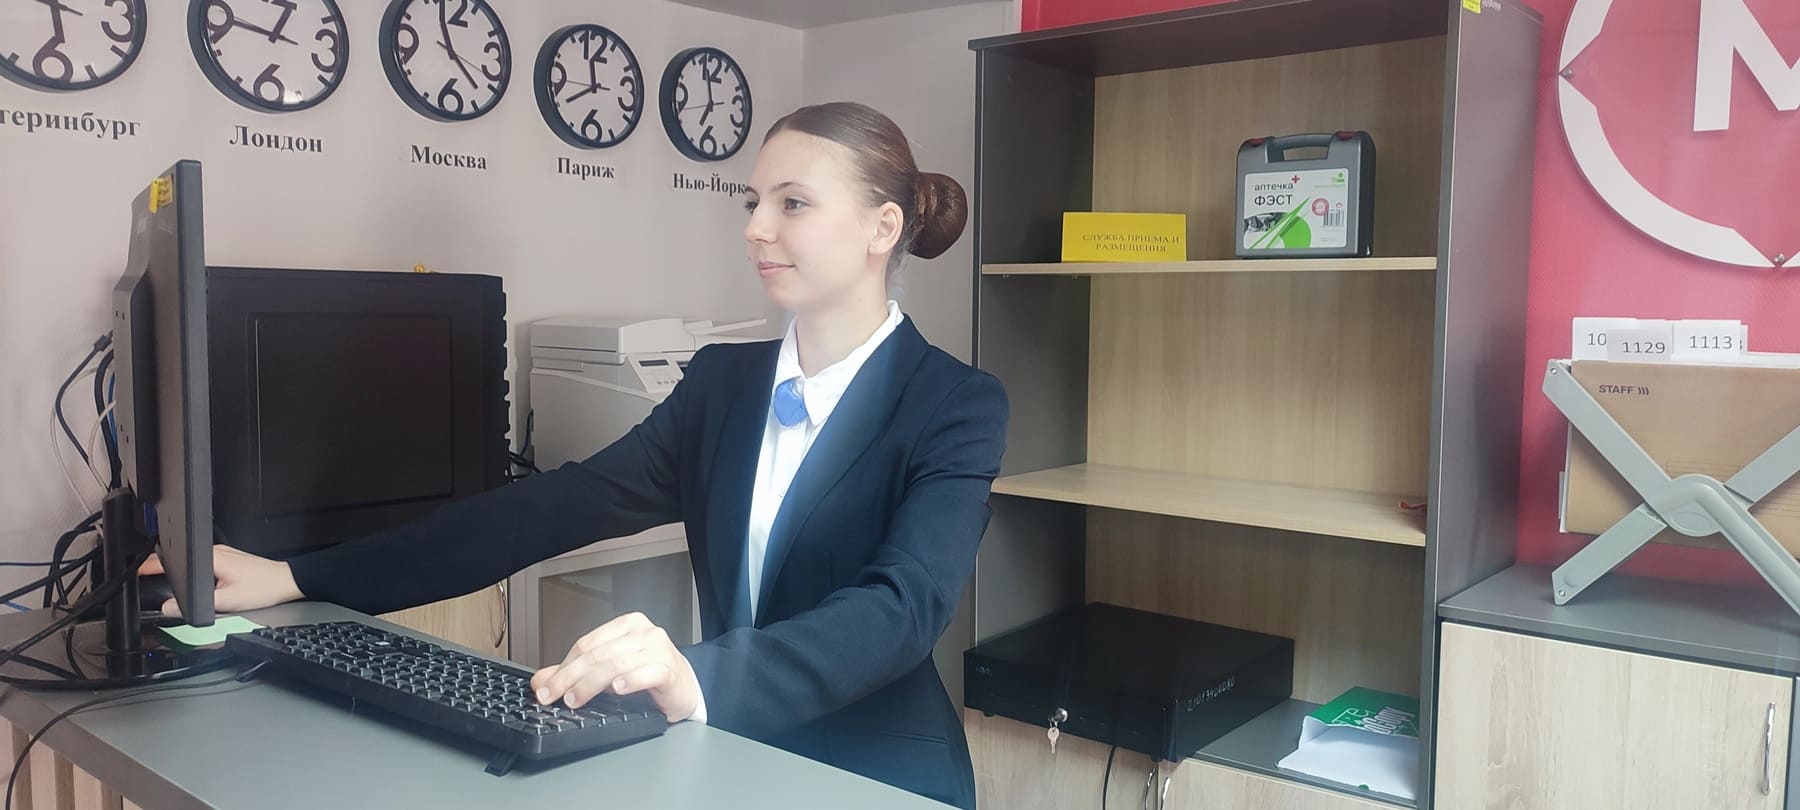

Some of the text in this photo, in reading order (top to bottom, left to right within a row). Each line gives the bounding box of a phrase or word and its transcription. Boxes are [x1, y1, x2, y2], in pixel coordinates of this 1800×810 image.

[101, 0, 134, 42] 3
[208, 0, 234, 44] 9
[33, 36, 73, 82] 6
[312, 29, 338, 73] 3
[398, 23, 419, 65] 9
[578, 30, 607, 64] 12
[481, 42, 502, 81] 3
[699, 54, 721, 84] 12
[253, 64, 284, 103] 6
[552, 61, 567, 96] 9
[618, 76, 634, 112] 3
[438, 78, 463, 114] 6
[730, 95, 744, 128] 3
[229, 125, 322, 153] Лондон
[581, 109, 602, 142] 6
[700, 125, 717, 155] 6
[411, 145, 487, 170] Москва
[558, 157, 614, 181] Париж
[673, 172, 746, 197] Нью-Йорк
[1254, 182, 1294, 191] аптечка
[1254, 195, 1293, 207] ФЭСТ
[1082, 233, 1125, 241] СЛУЖБА
[1128, 234, 1169, 243] ПРИЕМА
[1622, 341, 1666, 354] 1129
[1689, 335, 1733, 350] 1113
[1599, 384, 1634, 394] STAFF
